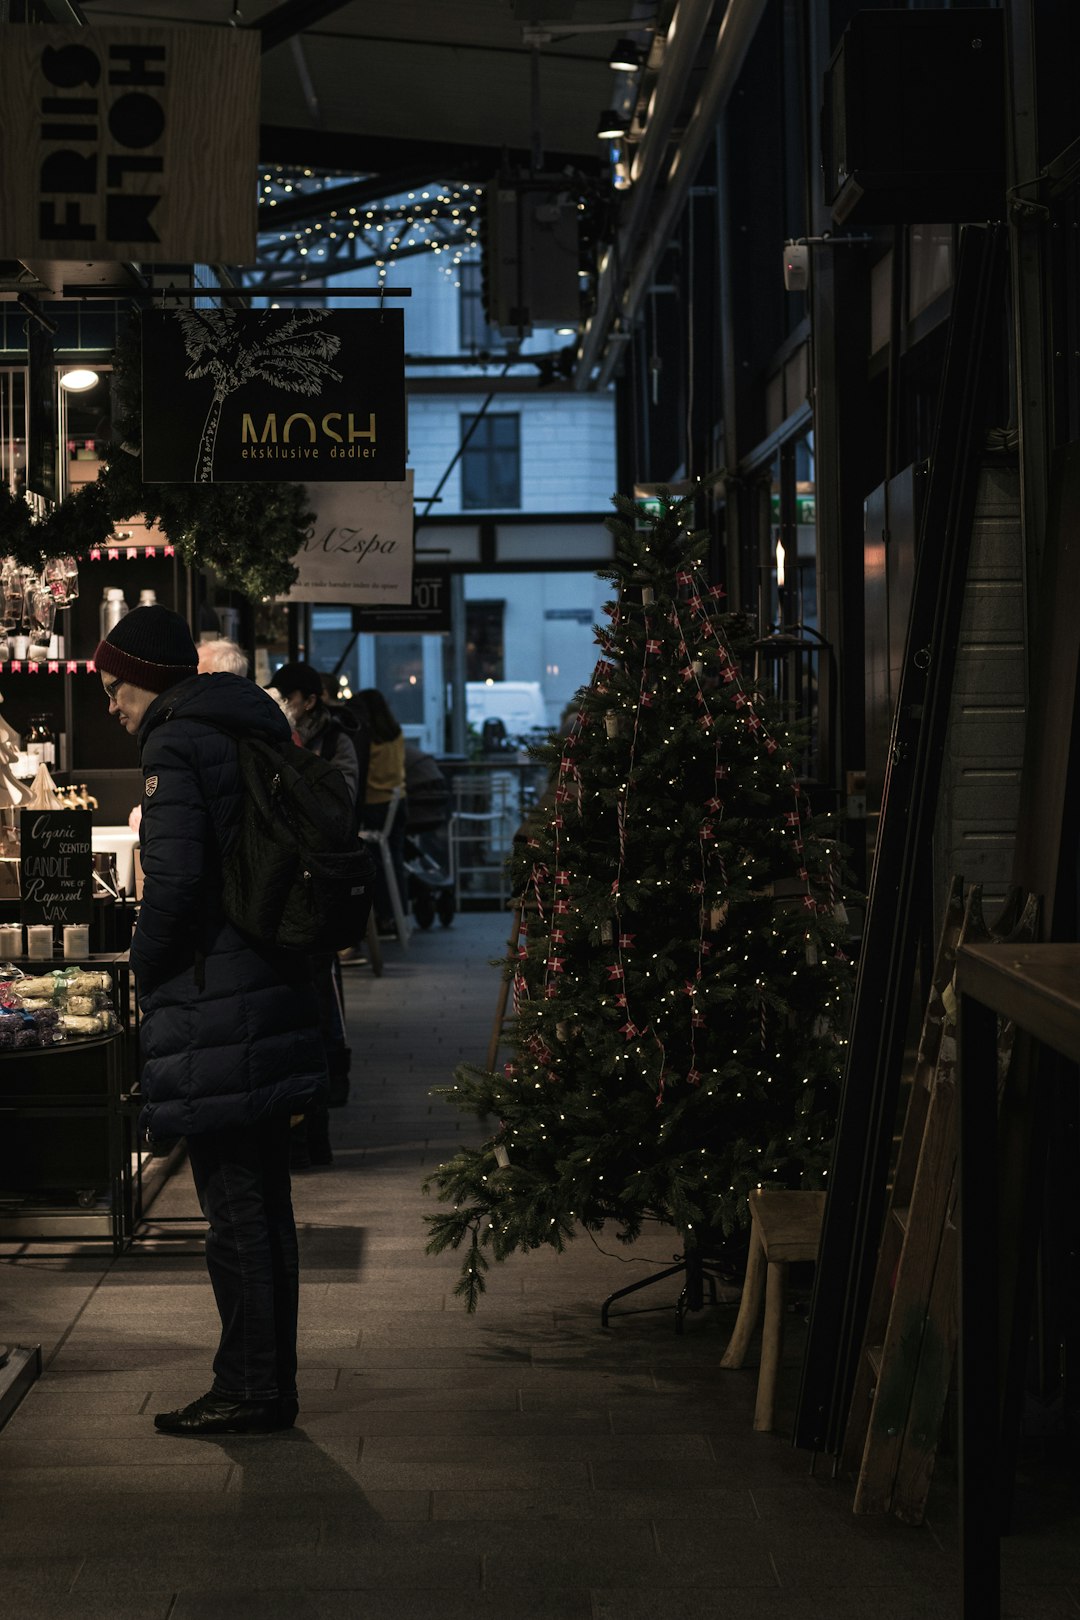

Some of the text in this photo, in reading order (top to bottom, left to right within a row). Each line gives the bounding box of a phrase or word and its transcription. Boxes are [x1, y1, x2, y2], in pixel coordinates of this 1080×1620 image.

[39, 43, 101, 241] FRIIS
[106, 44, 166, 243] HOLM
[241, 412, 377, 444] MOSH
[241, 445, 377, 459] eksklusive dadler
[32, 814, 76, 849] Organic
[59, 842, 90, 855] SCENTED
[24, 856, 72, 878] CANDLE
[42, 906, 68, 921] WAX
